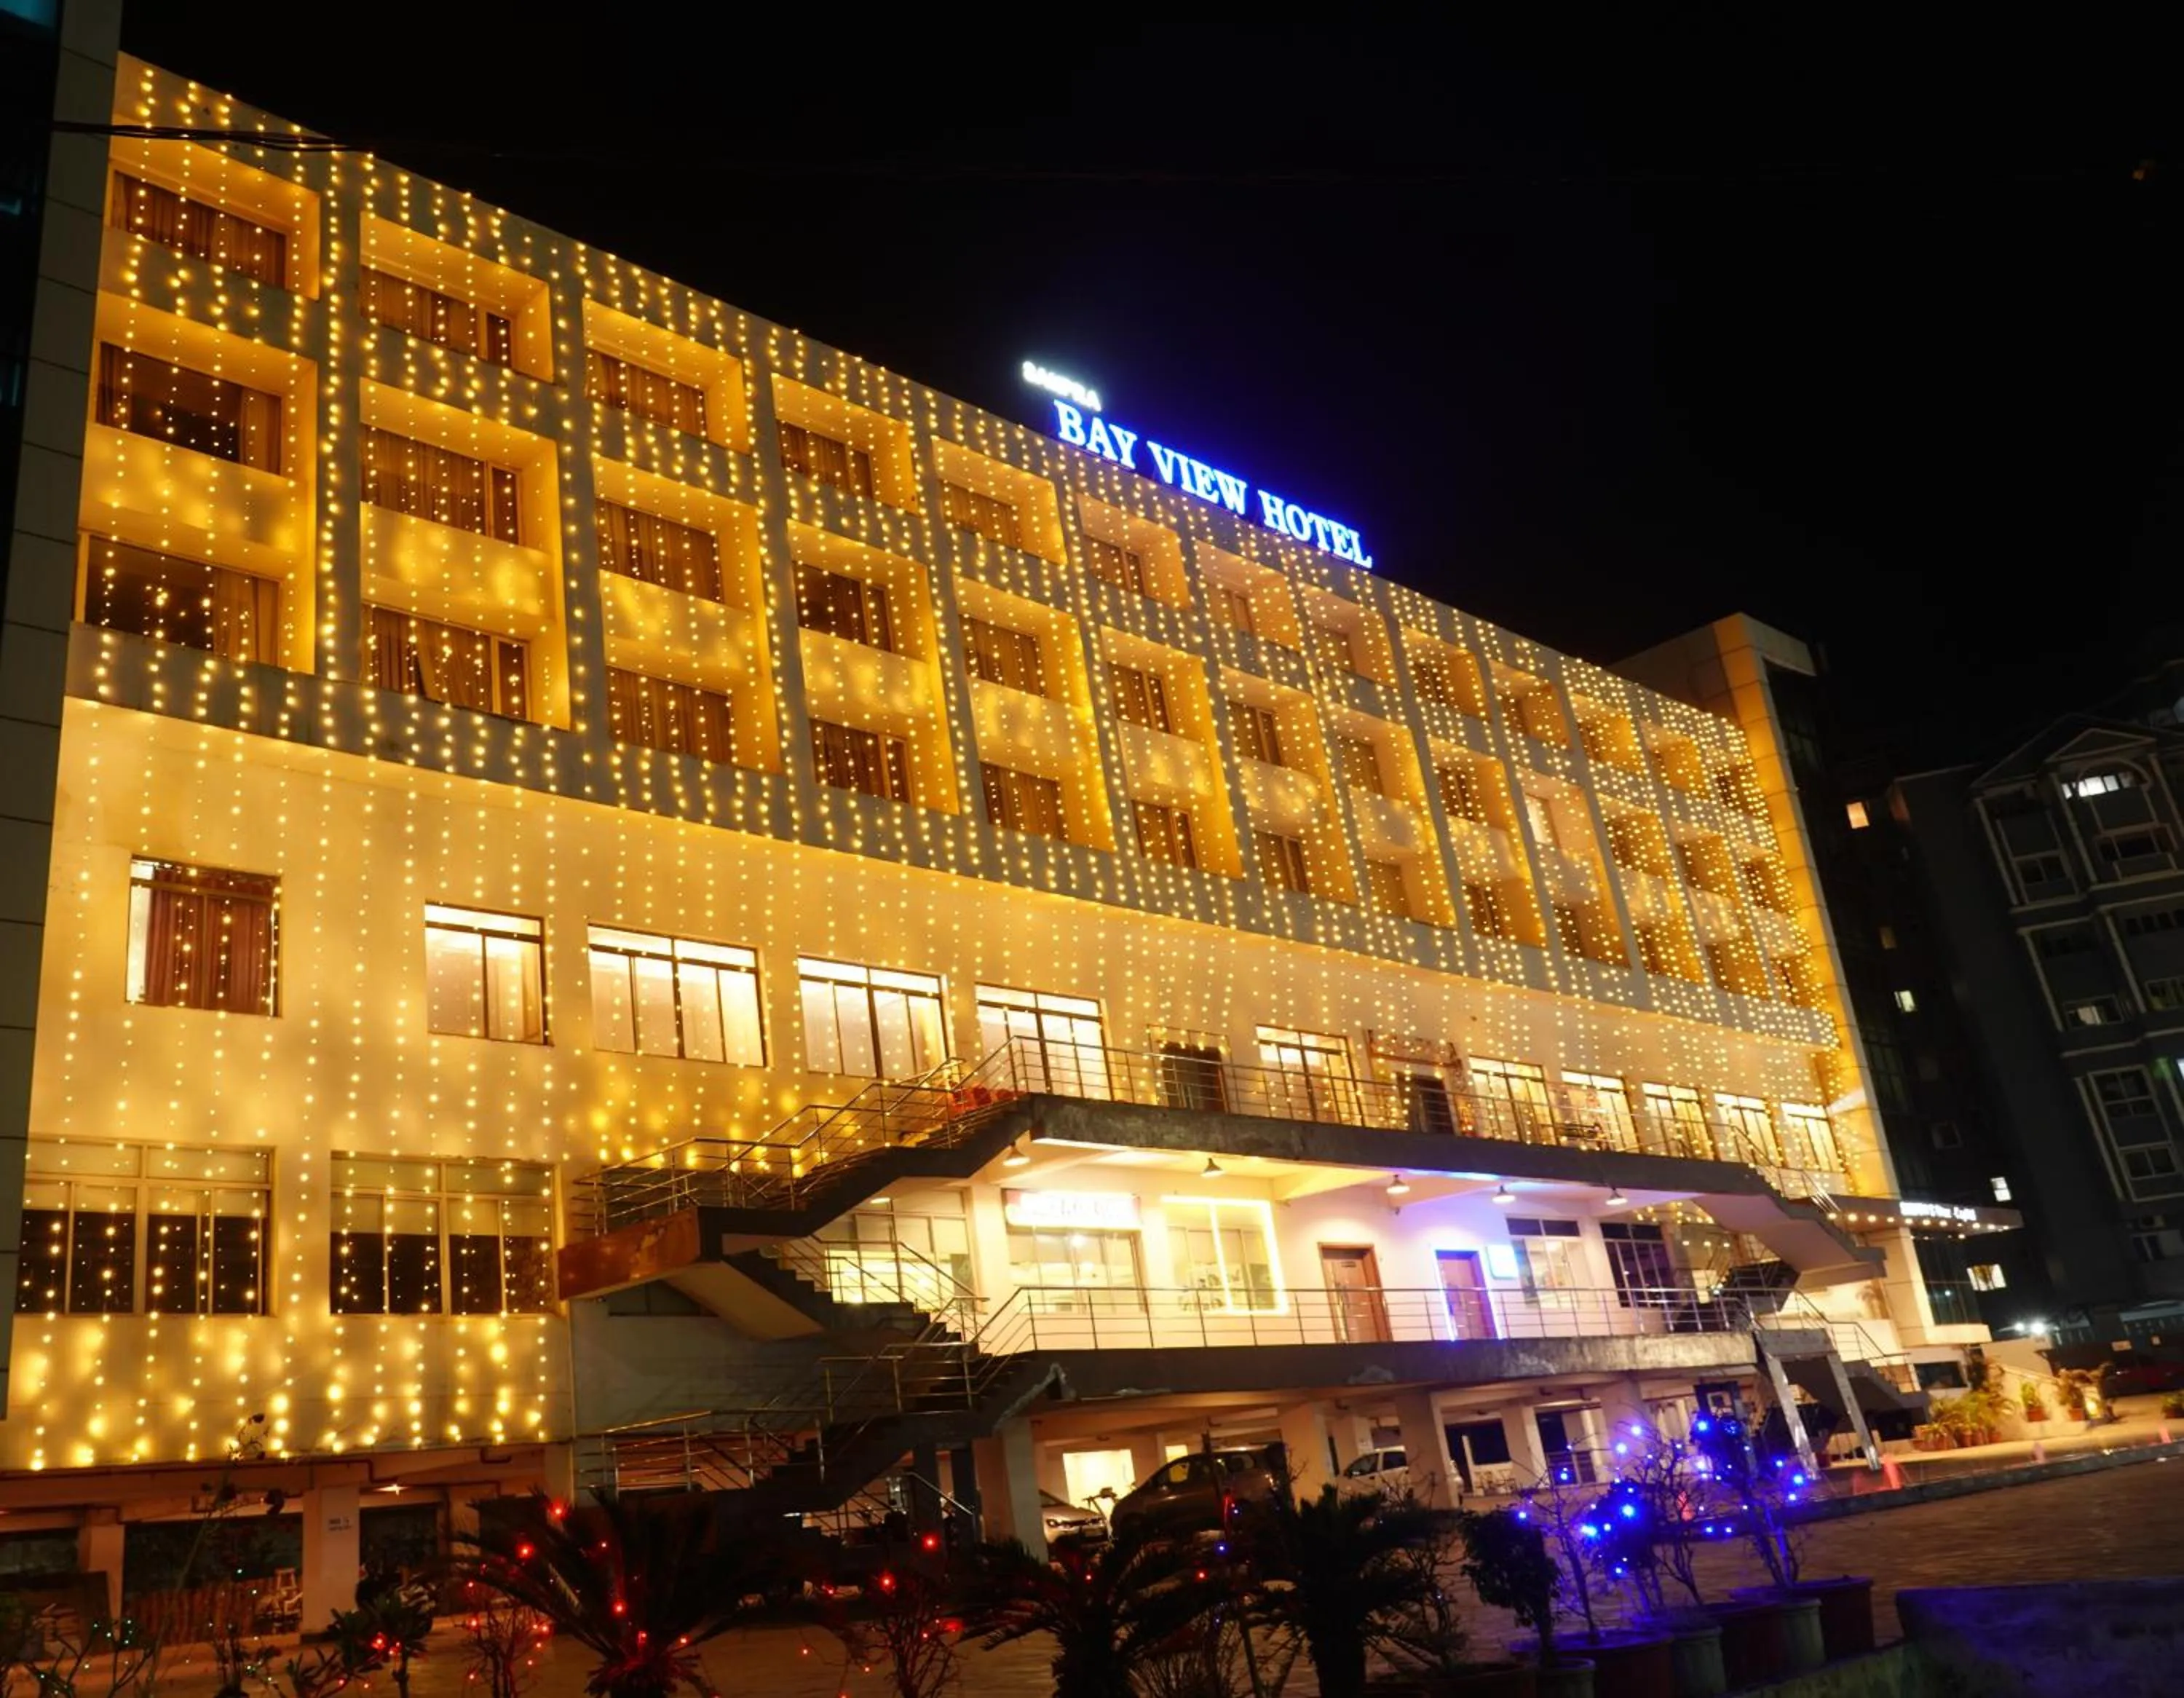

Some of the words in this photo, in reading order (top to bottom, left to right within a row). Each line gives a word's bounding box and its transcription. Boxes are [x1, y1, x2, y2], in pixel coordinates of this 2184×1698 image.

[1053, 399, 1138, 469] BAY
[1147, 441, 1247, 515] VIEW
[1257, 489, 1372, 569] HOTEL
